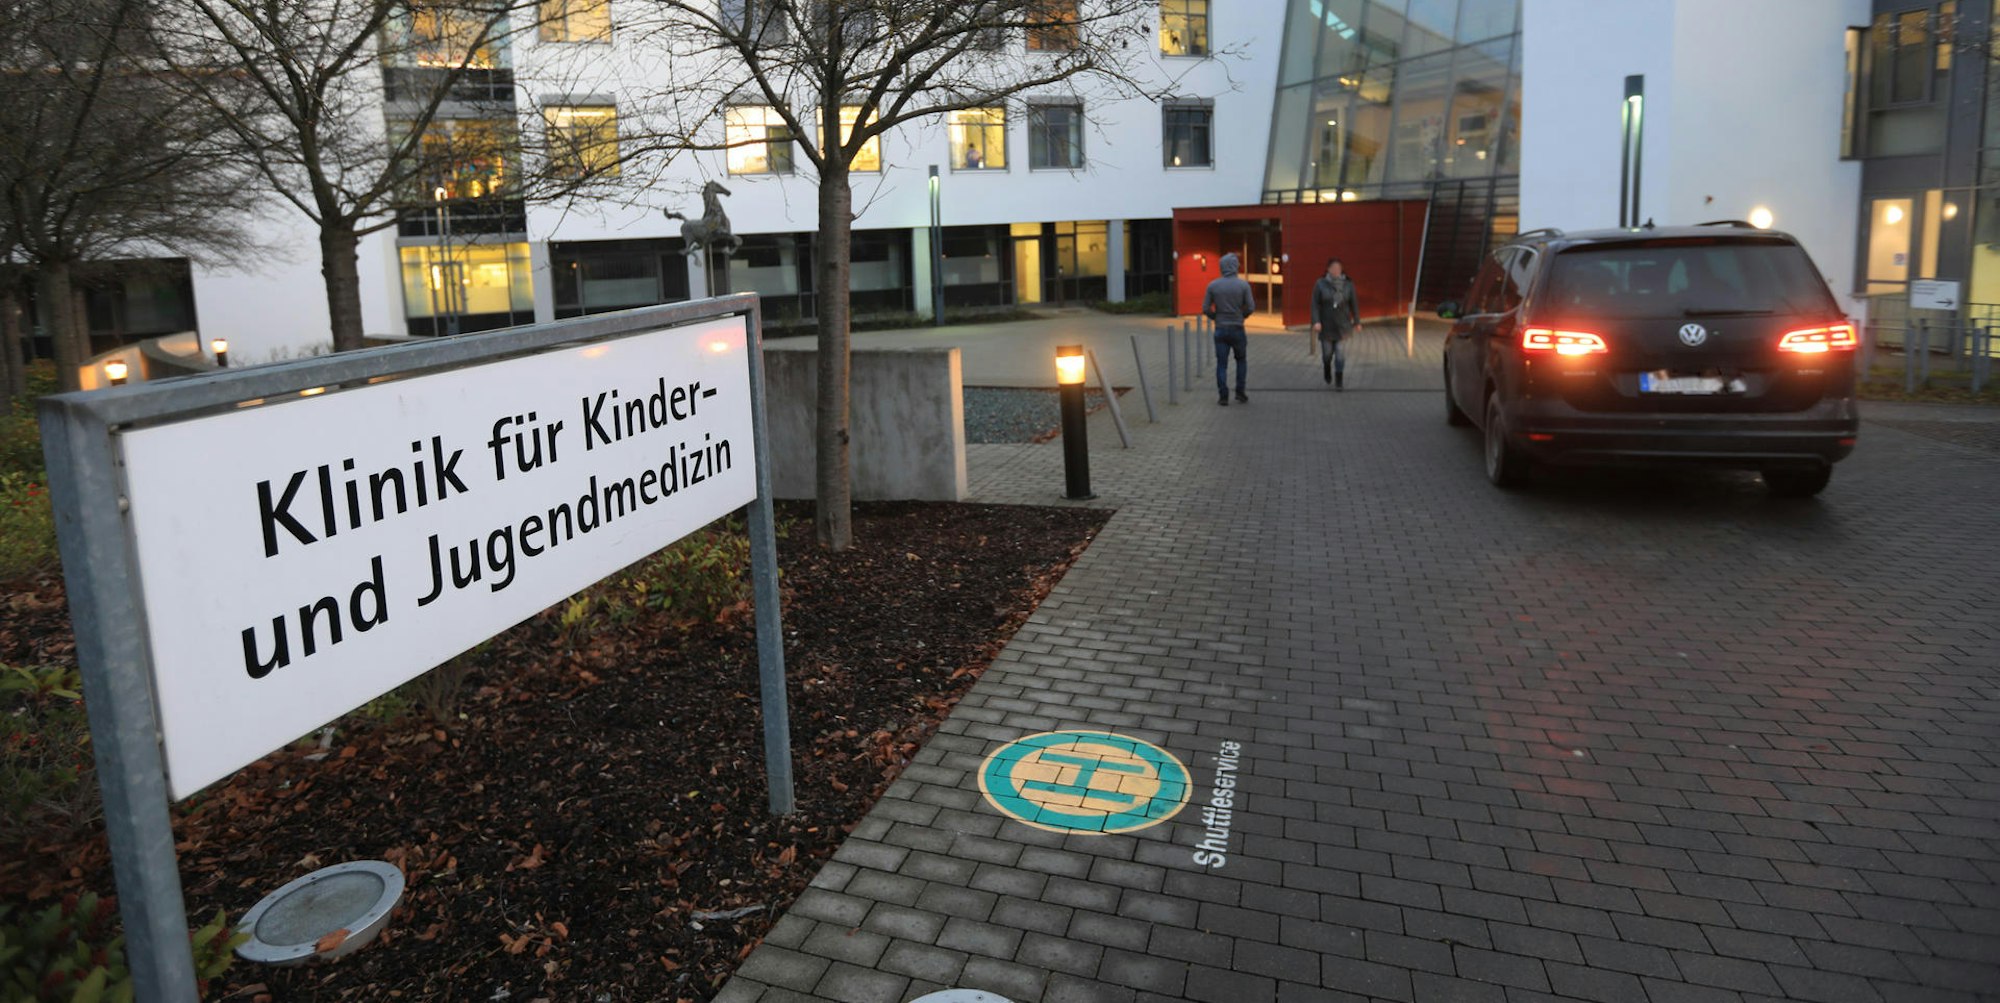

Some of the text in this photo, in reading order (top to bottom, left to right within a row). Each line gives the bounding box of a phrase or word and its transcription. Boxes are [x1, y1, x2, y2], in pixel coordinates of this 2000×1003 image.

[256, 376, 718, 559] Klinik für Kinder-
[241, 432, 732, 680] und Jugendmedizin
[1022, 752, 1146, 805] H
[1192, 740, 1241, 868] Shuttleservice
